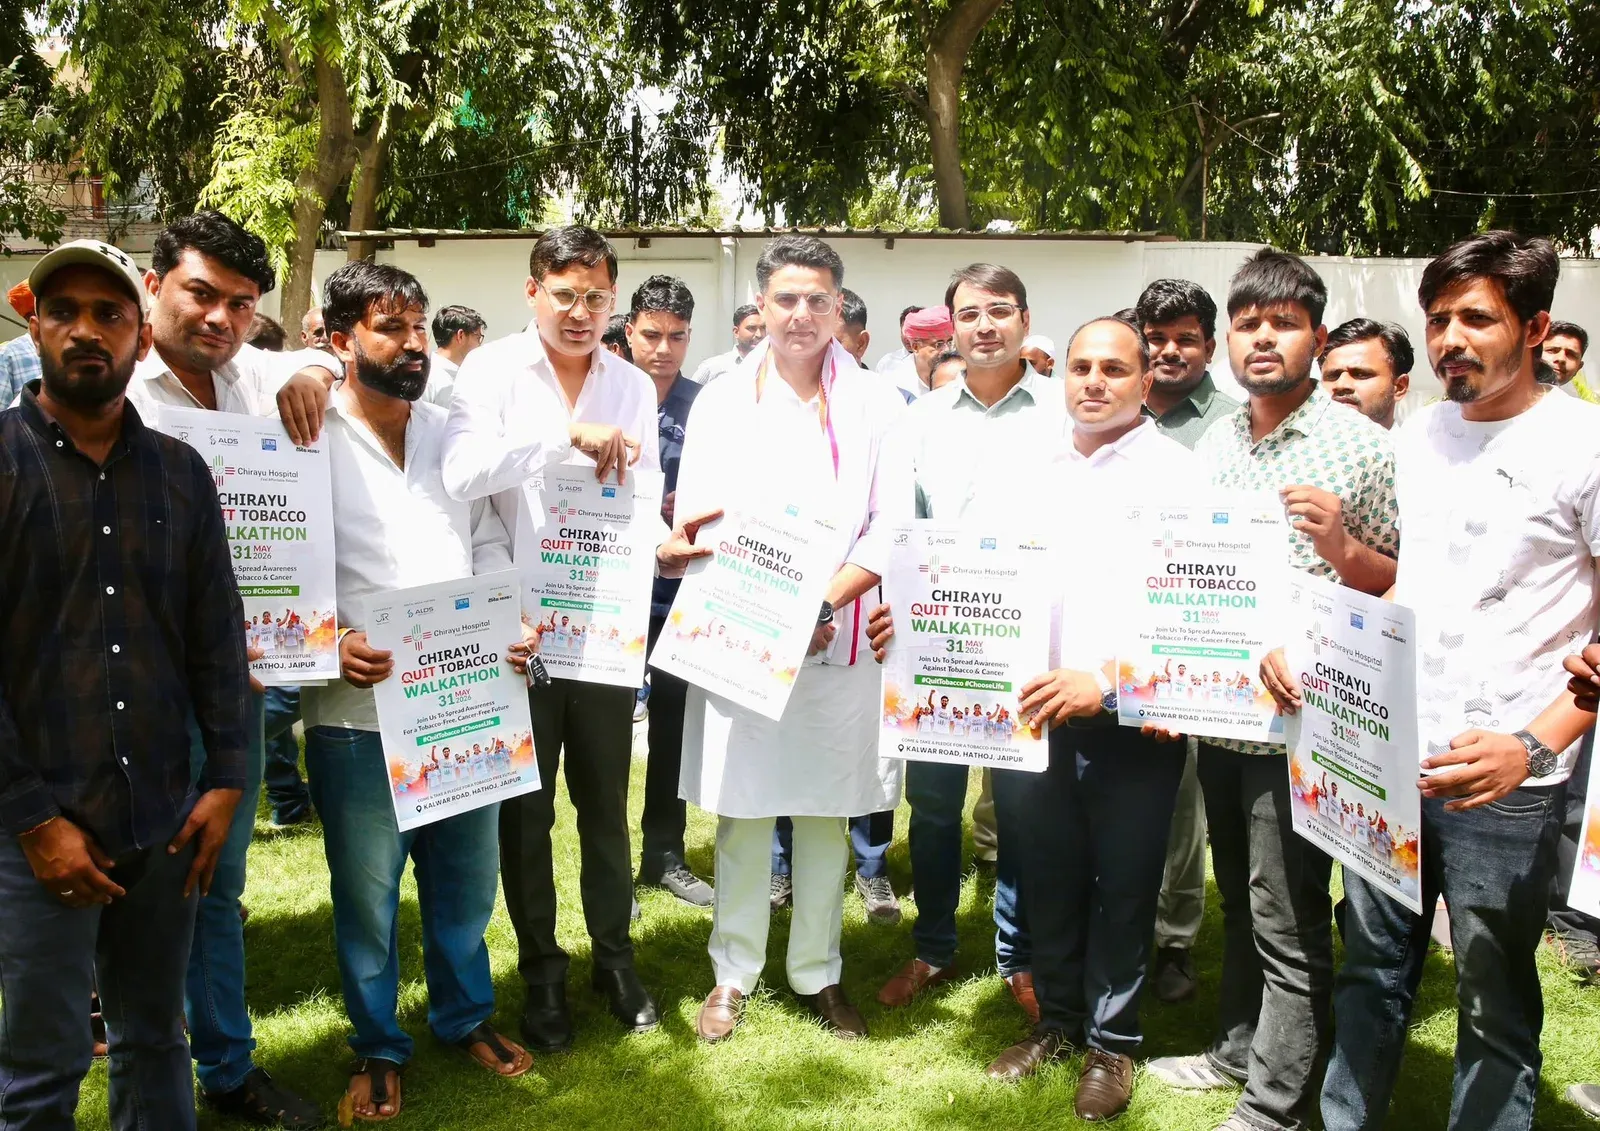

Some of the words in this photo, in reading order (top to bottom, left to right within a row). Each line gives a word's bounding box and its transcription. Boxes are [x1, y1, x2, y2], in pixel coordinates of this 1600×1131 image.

[238, 468, 266, 476] Chirayu
[269, 469, 298, 479] Hospital
[218, 493, 287, 506] CHIRAYU
[222, 509, 235, 521] IT
[240, 510, 306, 522] TOBACCO
[578, 509, 603, 518] Chirayu
[604, 512, 631, 521] Hospital
[226, 526, 306, 540] LKATHON
[559, 528, 617, 542] CHIRAYU
[233, 546, 251, 559] 31
[541, 538, 573, 551] QUIT
[576, 542, 632, 556] TOBACCO
[737, 535, 792, 564] CHIRAYU
[1186, 540, 1216, 550] Chirayu
[1218, 542, 1251, 551] Hospital
[541, 552, 630, 570] WALKATHON
[719, 541, 749, 559] QUIT
[751, 553, 803, 582] TOBACCO
[569, 570, 584, 580] 31
[716, 554, 800, 597] WALKATHON
[952, 566, 983, 575] Chirayu
[985, 568, 1018, 578] Hospital
[1166, 563, 1236, 577] CHIRAYU
[1147, 576, 1184, 590] QUIT
[1188, 578, 1256, 592] TOBACCO
[931, 589, 1002, 605] CHIRAYU
[1147, 592, 1256, 608] WALKATHON
[910, 603, 949, 617] QUIT
[953, 605, 1022, 620] TOBACCO
[1183, 610, 1200, 623] 31
[434, 627, 460, 637] Chirayu
[462, 620, 490, 631] Hospital
[911, 619, 1021, 638] WALKATHON
[1211, 629, 1246, 637] Awareness
[946, 639, 964, 653] 31
[1201, 636, 1239, 644] Cancer-Free
[418, 644, 480, 665] CHIRAYU
[965, 647, 984, 655] 2026
[1330, 640, 1353, 656] Chirayu
[1355, 648, 1382, 667] Hospital
[253, 662, 286, 670] HATHOJ,
[401, 666, 435, 684] QUIT
[439, 653, 498, 674] TOBACCO
[922, 664, 946, 672] Against
[948, 666, 973, 674] Tobacco
[982, 669, 1004, 677] Cancer
[951, 658, 973, 666] Spread
[974, 660, 1009, 668] Awareness
[404, 666, 500, 699] WALKATHON
[921, 678, 964, 687] #QuitTobacco
[965, 681, 1004, 690] #ChooseLife
[1316, 662, 1370, 696] CHIRAYU
[438, 693, 455, 707] 31
[455, 688, 471, 698] MAY
[456, 695, 472, 704] 2026
[1301, 671, 1329, 693] QUIT
[1332, 684, 1389, 720] TOBACCO
[416, 715, 428, 724] Join
[445, 708, 465, 718] Spread
[465, 701, 495, 712] Awareness
[458, 709, 490, 721] Cancer-Free
[491, 704, 509, 714] Future
[1147, 711, 1177, 719] KALWAR
[1178, 714, 1200, 722] ROAD,
[1303, 688, 1390, 742] WALKATHON
[1331, 721, 1345, 741] 31
[1346, 728, 1359, 740] MAY
[1346, 735, 1360, 748] 2026
[906, 746, 937, 754] KALWAR
[938, 749, 961, 757] ROAD,
[963, 752, 995, 761] HATHOJ,
[997, 755, 1023, 763] JAIPUR
[1313, 731, 1321, 739] Join
[1323, 736, 1329, 744] Us
[1330, 739, 1335, 748] To
[1336, 743, 1353, 758] Spread
[1354, 753, 1382, 773] Awareness
[1316, 742, 1334, 756] Against
[1335, 751, 1354, 767] Tobacco
[1360, 766, 1378, 780] Cancer
[424, 796, 450, 809] KALWAR
[452, 791, 471, 801] ROAD,
[472, 783, 499, 795] HATHOJ,
[500, 776, 522, 787] JAIPUR
[1313, 824, 1334, 842] KALWAR
[1379, 867, 1400, 886] JAIPUR
